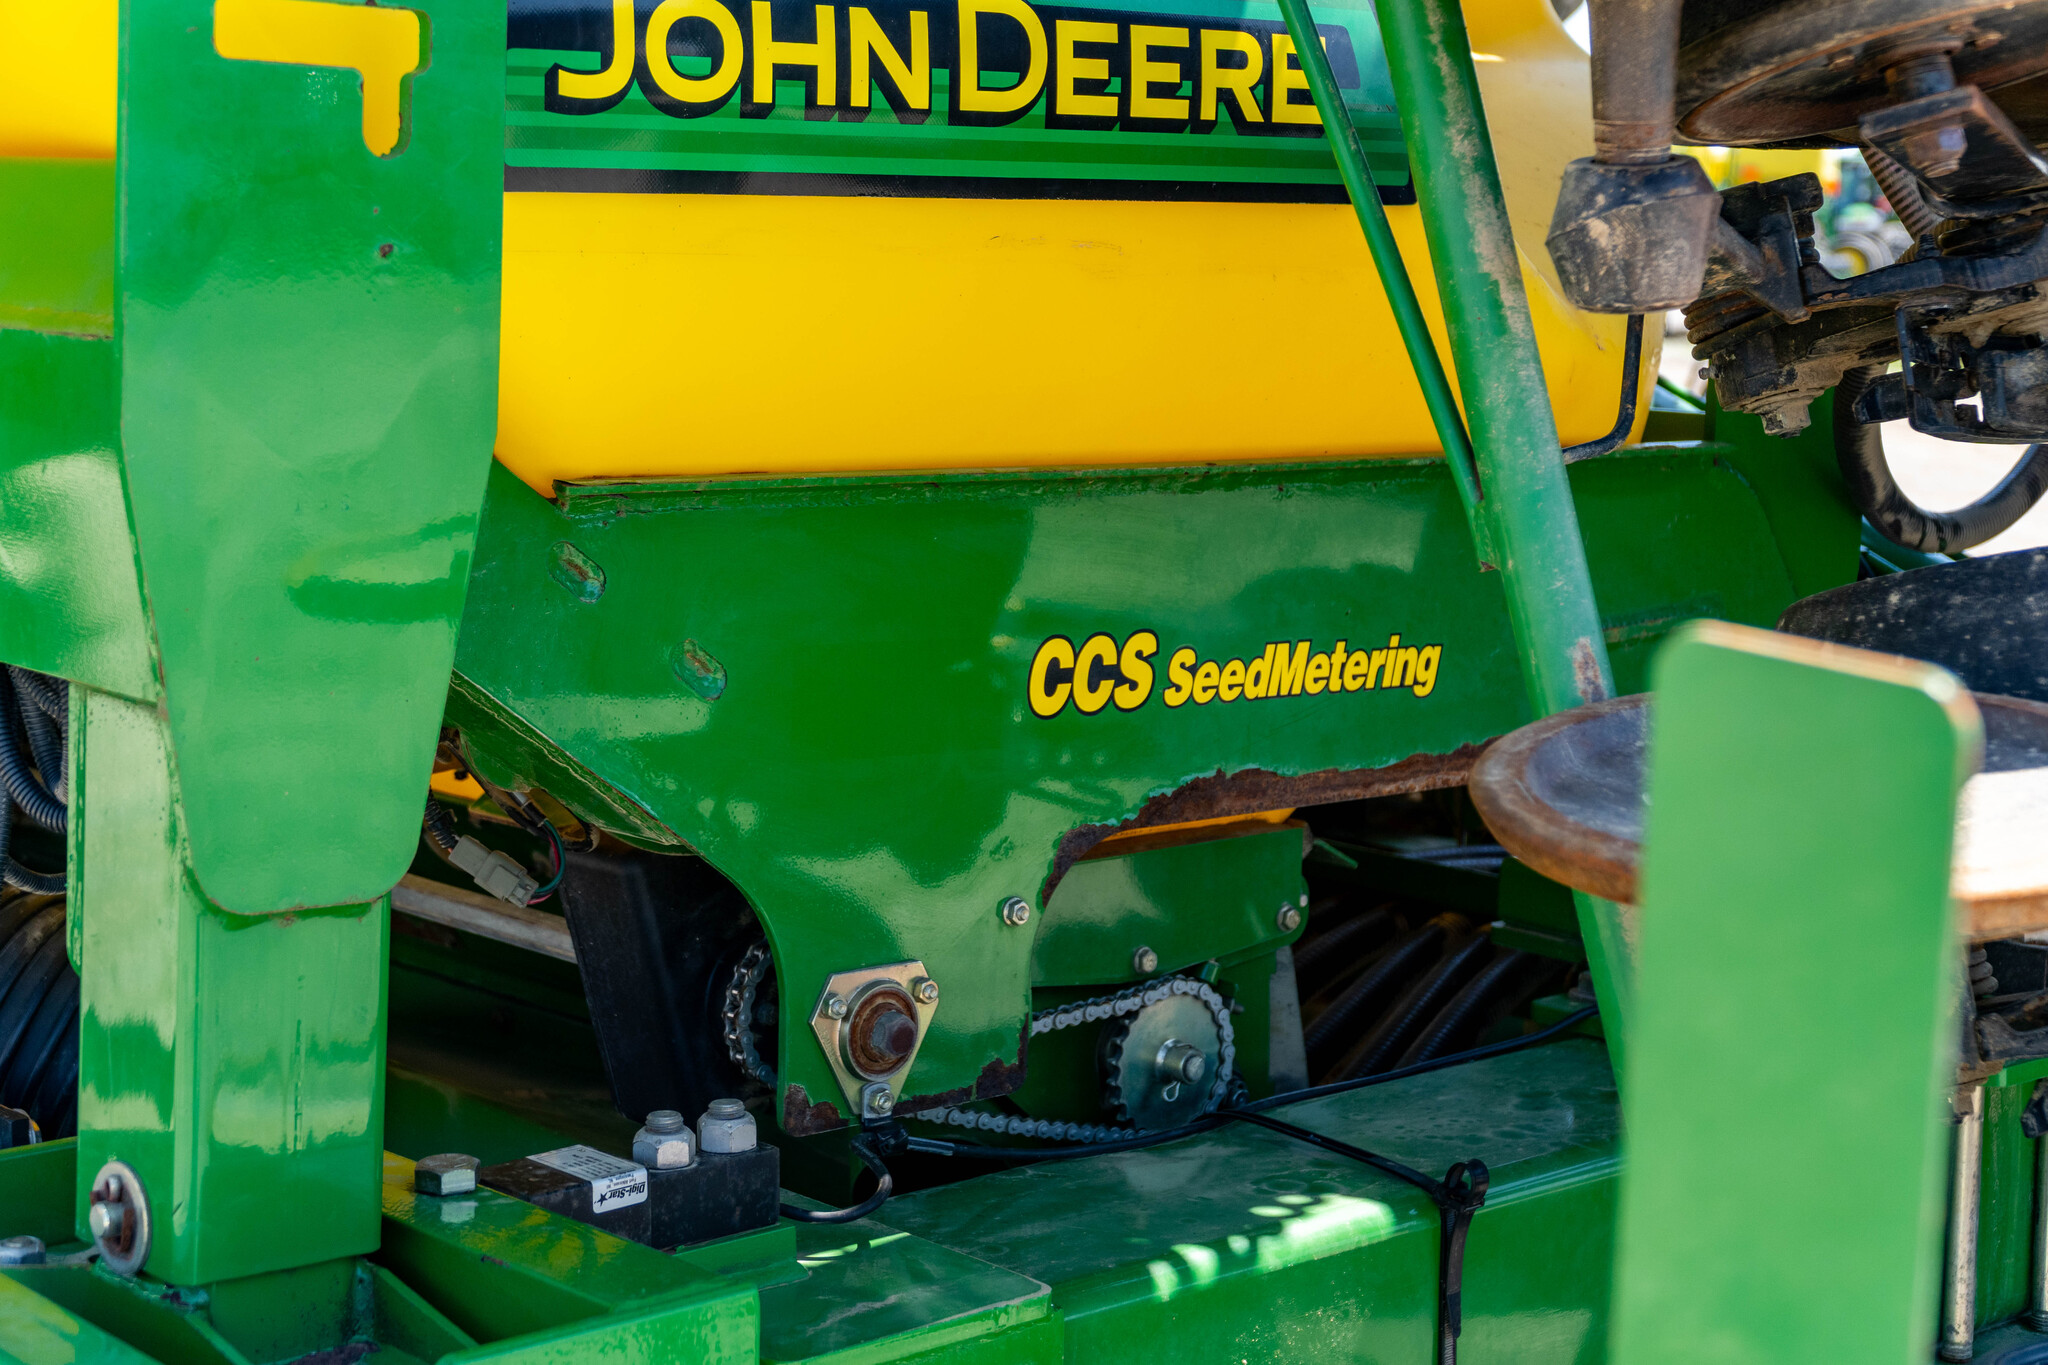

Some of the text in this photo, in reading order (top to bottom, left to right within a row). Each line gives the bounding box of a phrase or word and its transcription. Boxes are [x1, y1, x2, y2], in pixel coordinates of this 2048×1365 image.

[550, 0, 1326, 130] JOHN DEERE
[1028, 628, 1443, 720] CCS SeedMetering
[608, 1181, 646, 1199] Digi-Star
